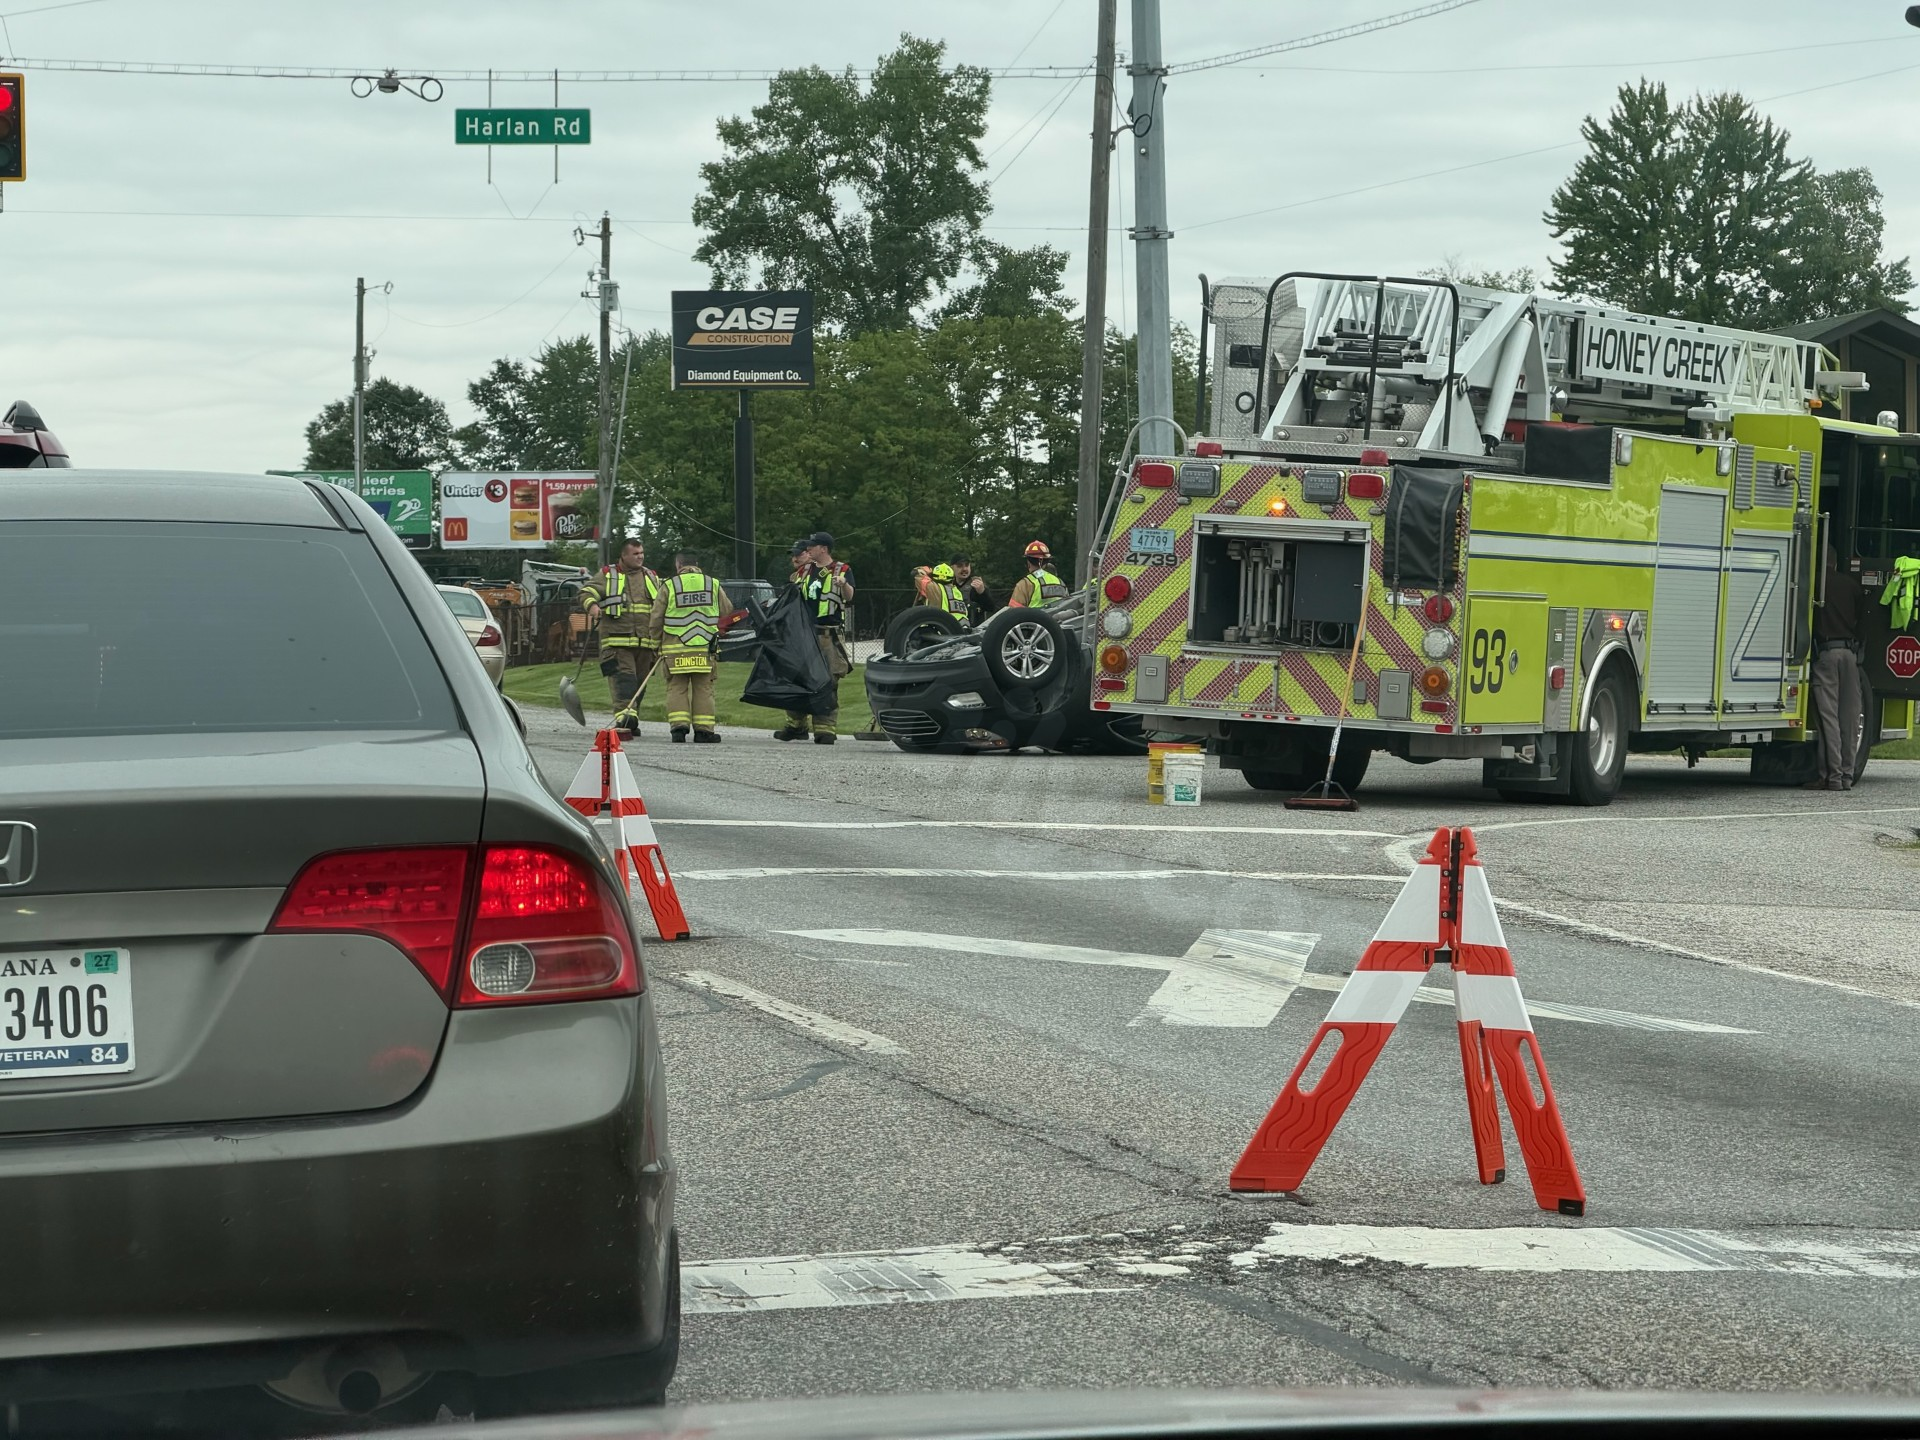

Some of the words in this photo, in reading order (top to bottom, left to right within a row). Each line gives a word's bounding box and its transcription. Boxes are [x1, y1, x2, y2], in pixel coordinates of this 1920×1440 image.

[465, 117, 539, 136] Harlan
[554, 117, 581, 136] Rd
[696, 306, 800, 331] CASE
[706, 334, 790, 344] CONSTRUCTION
[1585, 325, 1662, 376] HONEY
[1663, 337, 1730, 385] CREEK
[687, 369, 731, 381] Diamond
[733, 369, 784, 382] Equipment
[786, 369, 801, 381] Co.
[444, 484, 483, 498] Under
[1137, 534, 1168, 547] 47799
[1125, 552, 1178, 567] 4739
[682, 593, 707, 604] FIRE
[675, 656, 707, 667] EDINGTON
[1470, 628, 1507, 695] 93
[1889, 648, 1920, 665] STOP
[93, 954, 112, 968] 27
[4, 983, 108, 1041] 3406
[91, 1045, 119, 1063] 84
